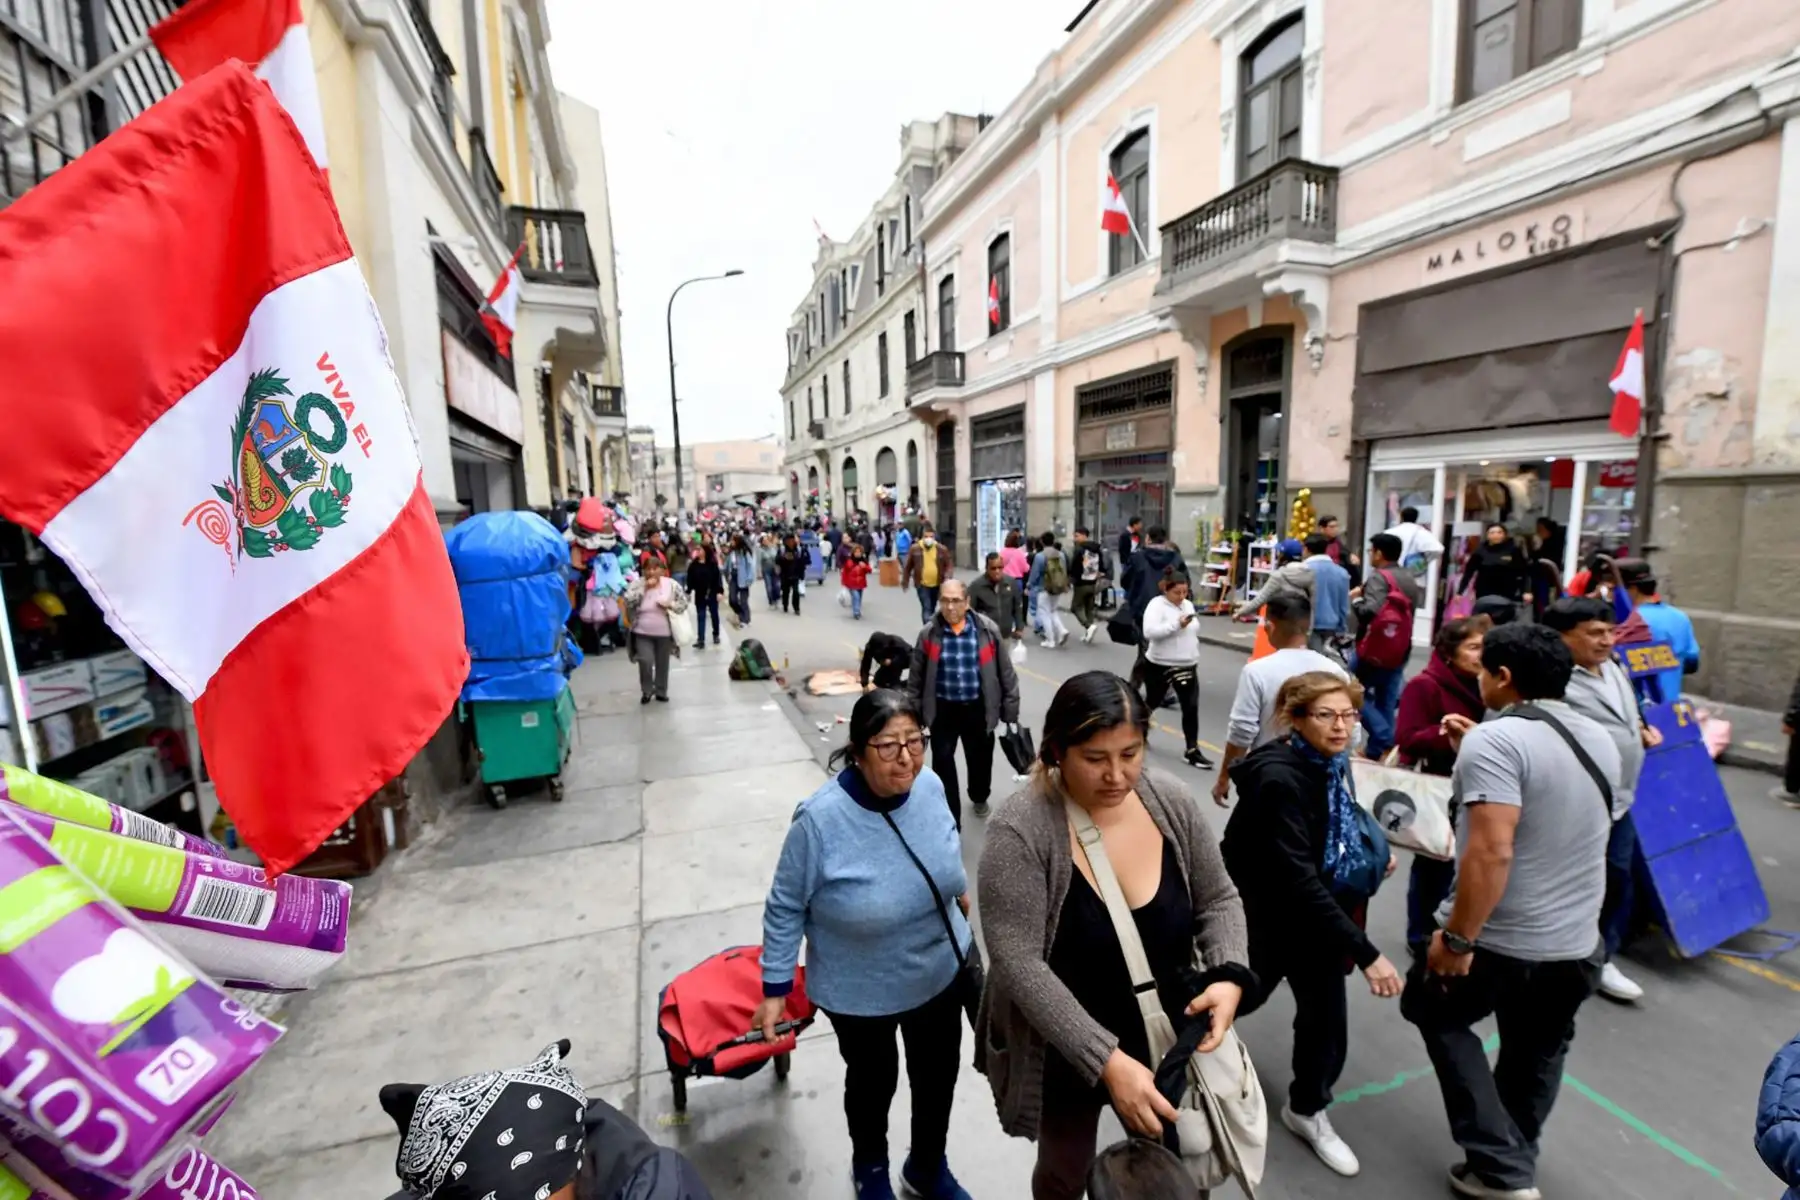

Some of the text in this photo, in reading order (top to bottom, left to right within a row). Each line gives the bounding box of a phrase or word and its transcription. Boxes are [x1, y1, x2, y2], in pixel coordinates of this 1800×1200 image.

[1427, 214, 1571, 271] MALOKO
[1528, 233, 1571, 254] KIDS
[316, 350, 372, 459] VIVA EL
[149, 1048, 195, 1086] 70
